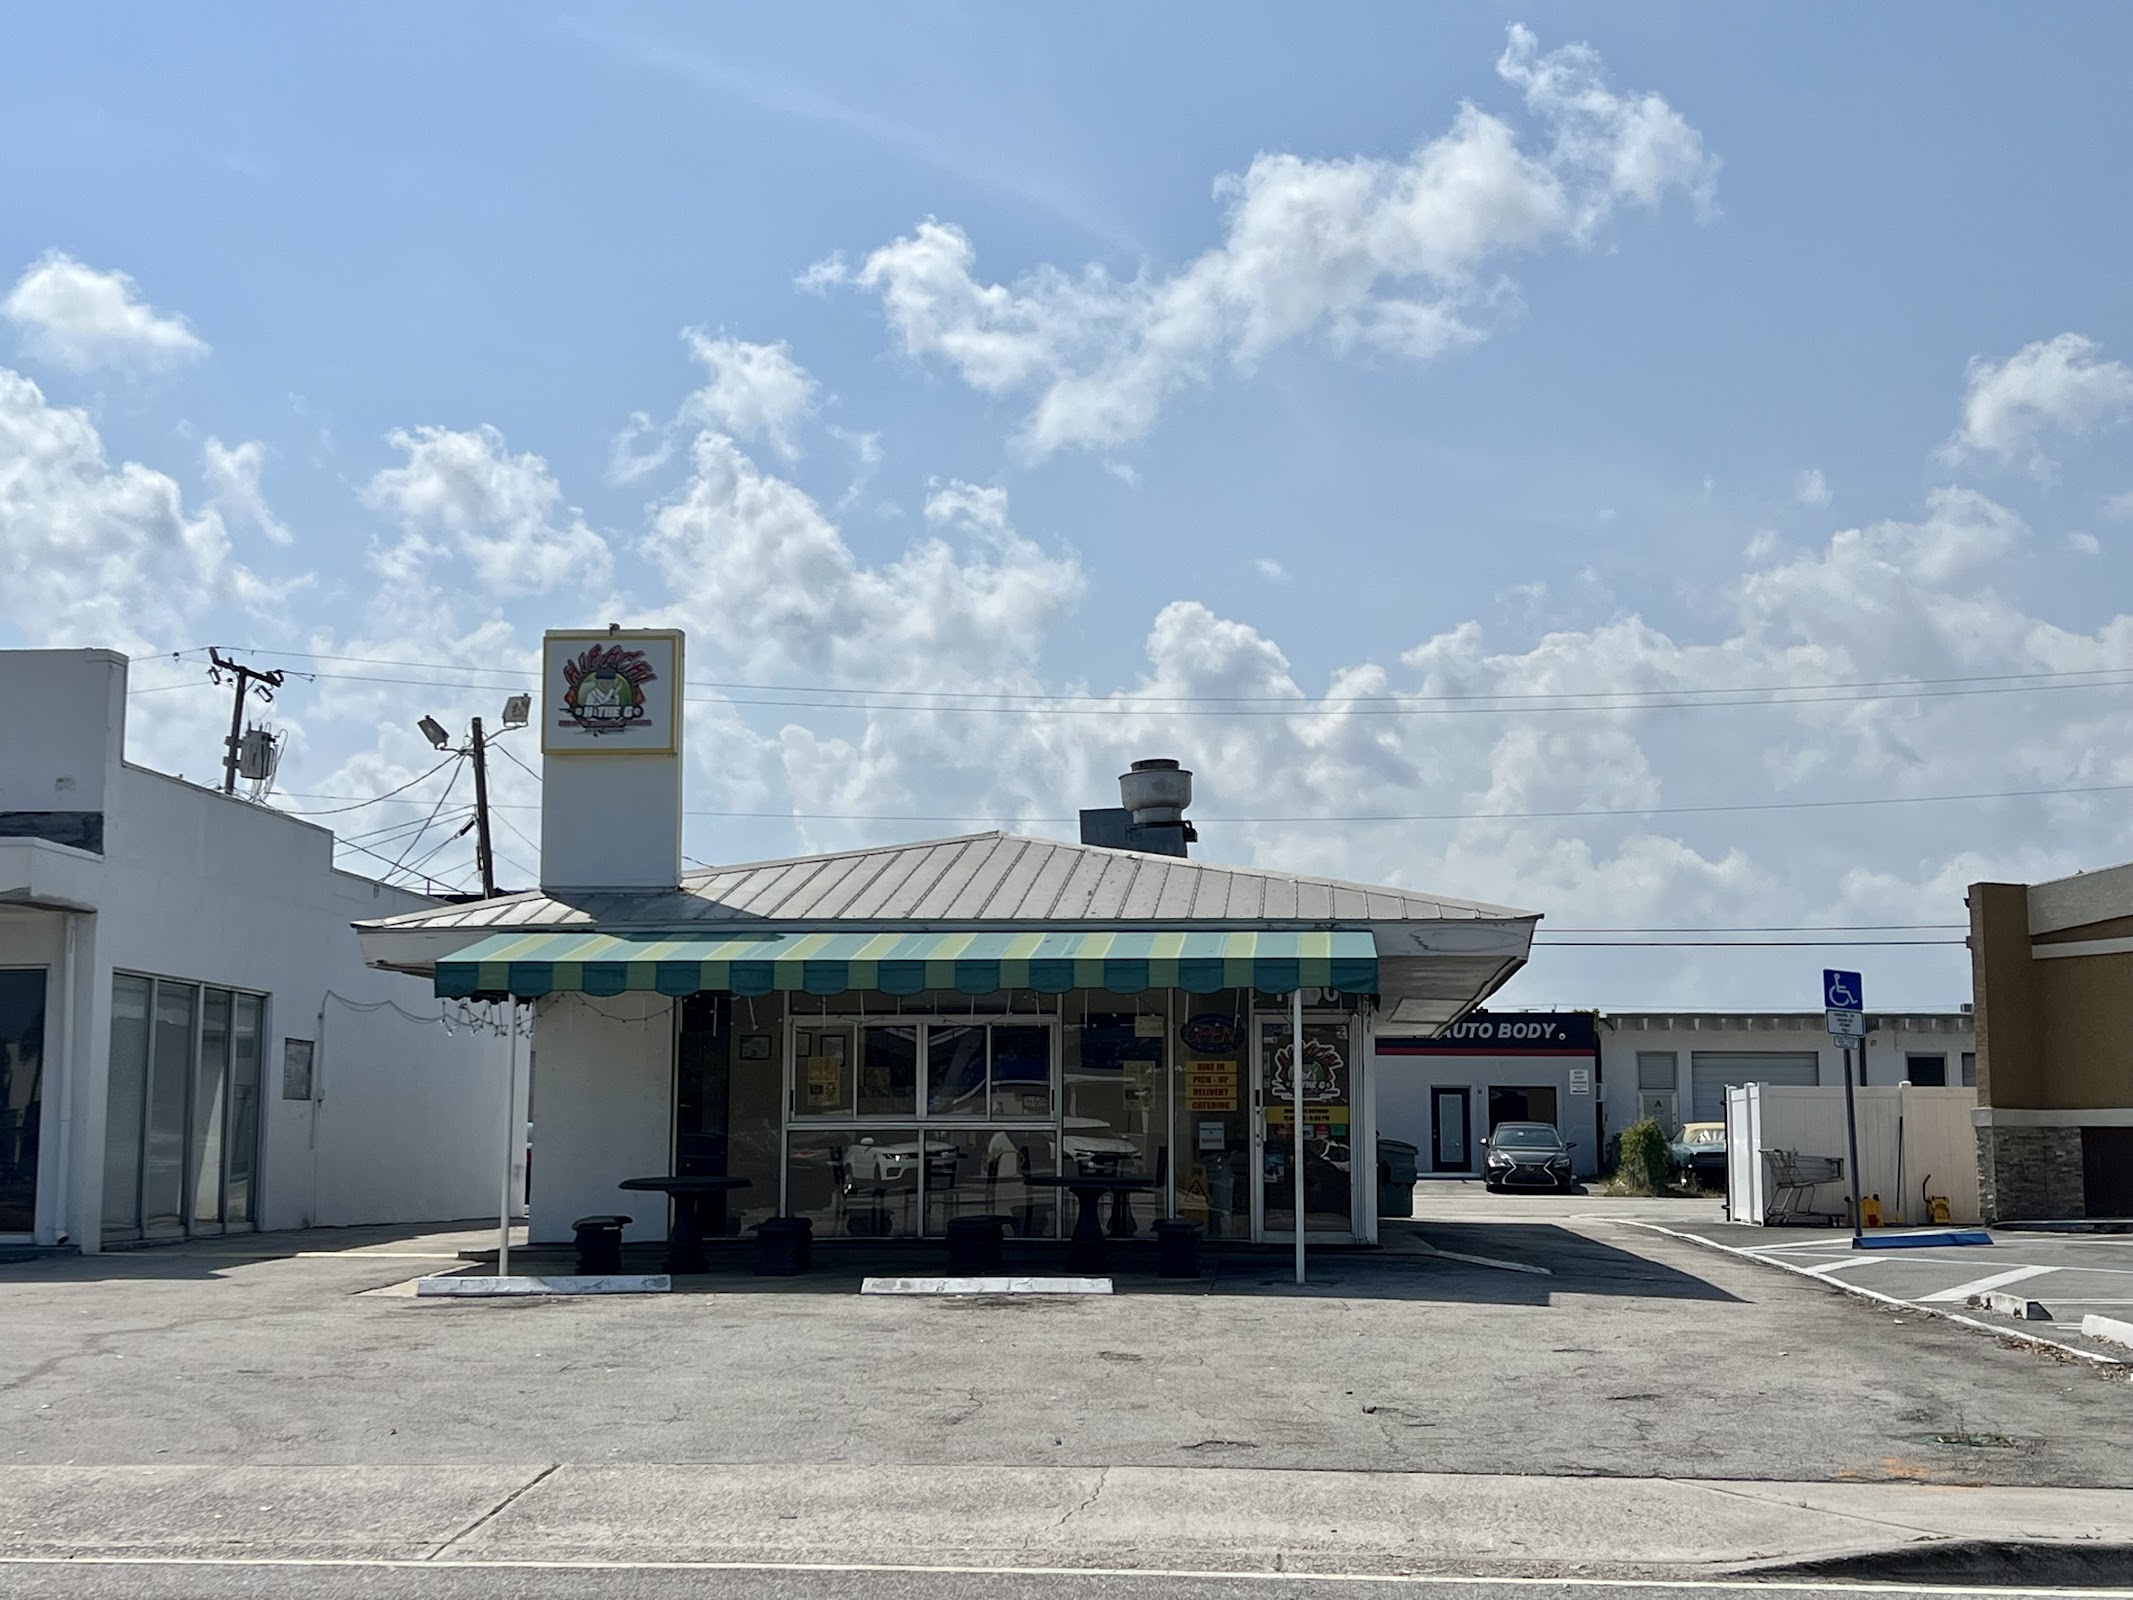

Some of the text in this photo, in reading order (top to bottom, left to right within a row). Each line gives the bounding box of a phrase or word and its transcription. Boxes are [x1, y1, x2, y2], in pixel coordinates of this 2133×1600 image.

[597, 706, 621, 718] THE
[623, 706, 643, 718] GO
[1185, 1024, 1235, 1043] OPEN
[1193, 1089, 1229, 1097] DELIVERY
[1192, 1102, 1230, 1110] CATERING
